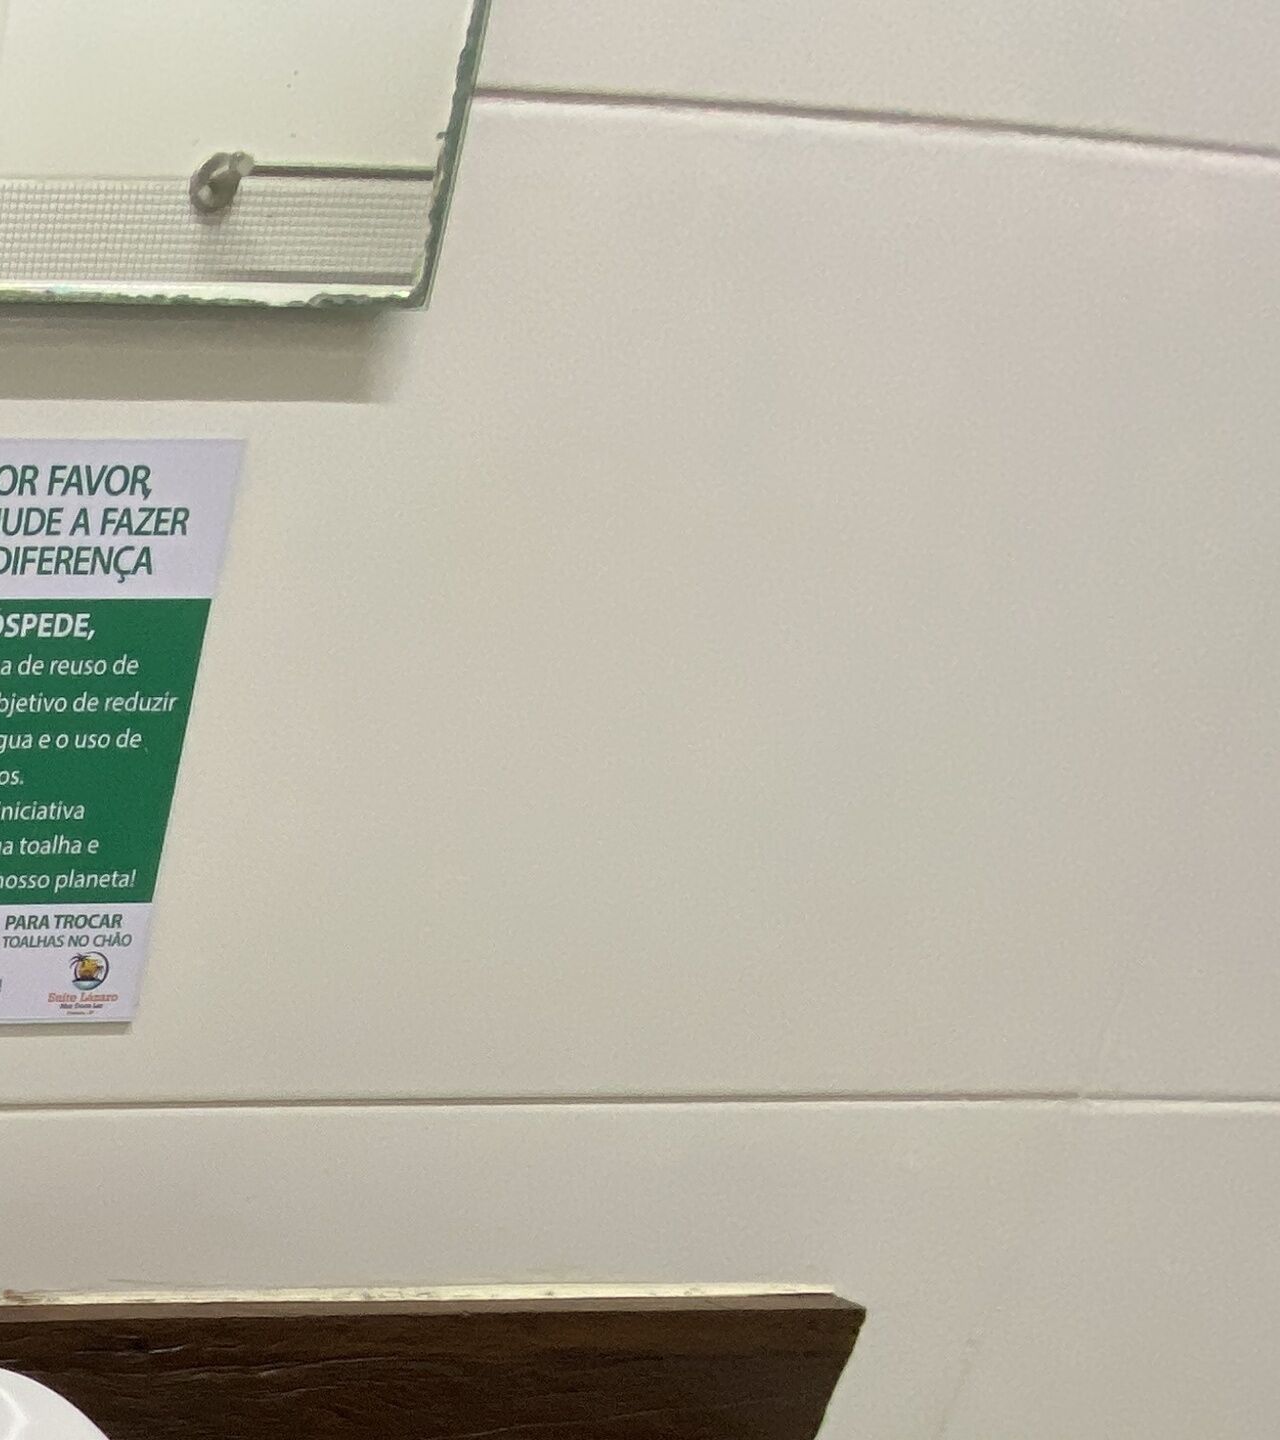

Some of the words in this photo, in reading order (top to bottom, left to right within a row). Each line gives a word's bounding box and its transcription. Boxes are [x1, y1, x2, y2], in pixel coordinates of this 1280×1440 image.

[47, 463, 153, 500] FAVOR,
[69, 508, 90, 536] A
[100, 507, 190, 536] FAZER
[18, 654, 44, 676] de
[49, 656, 107, 676] reuso
[112, 653, 139, 675] de
[73, 691, 99, 713] de
[105, 691, 178, 712] reduzir
[39, 732, 51, 749] e
[56, 732, 69, 749] o
[74, 732, 111, 749] uso
[116, 728, 142, 749] de
[19, 834, 81, 855] toalha
[87, 838, 99, 854] e
[54, 869, 137, 894] planeta!
[4, 914, 51, 930] PARA
[54, 913, 123, 929] TROCAR
[3, 934, 64, 949] TOALHAS
[67, 934, 90, 948] NO
[92, 931, 132, 947] CHÃO
